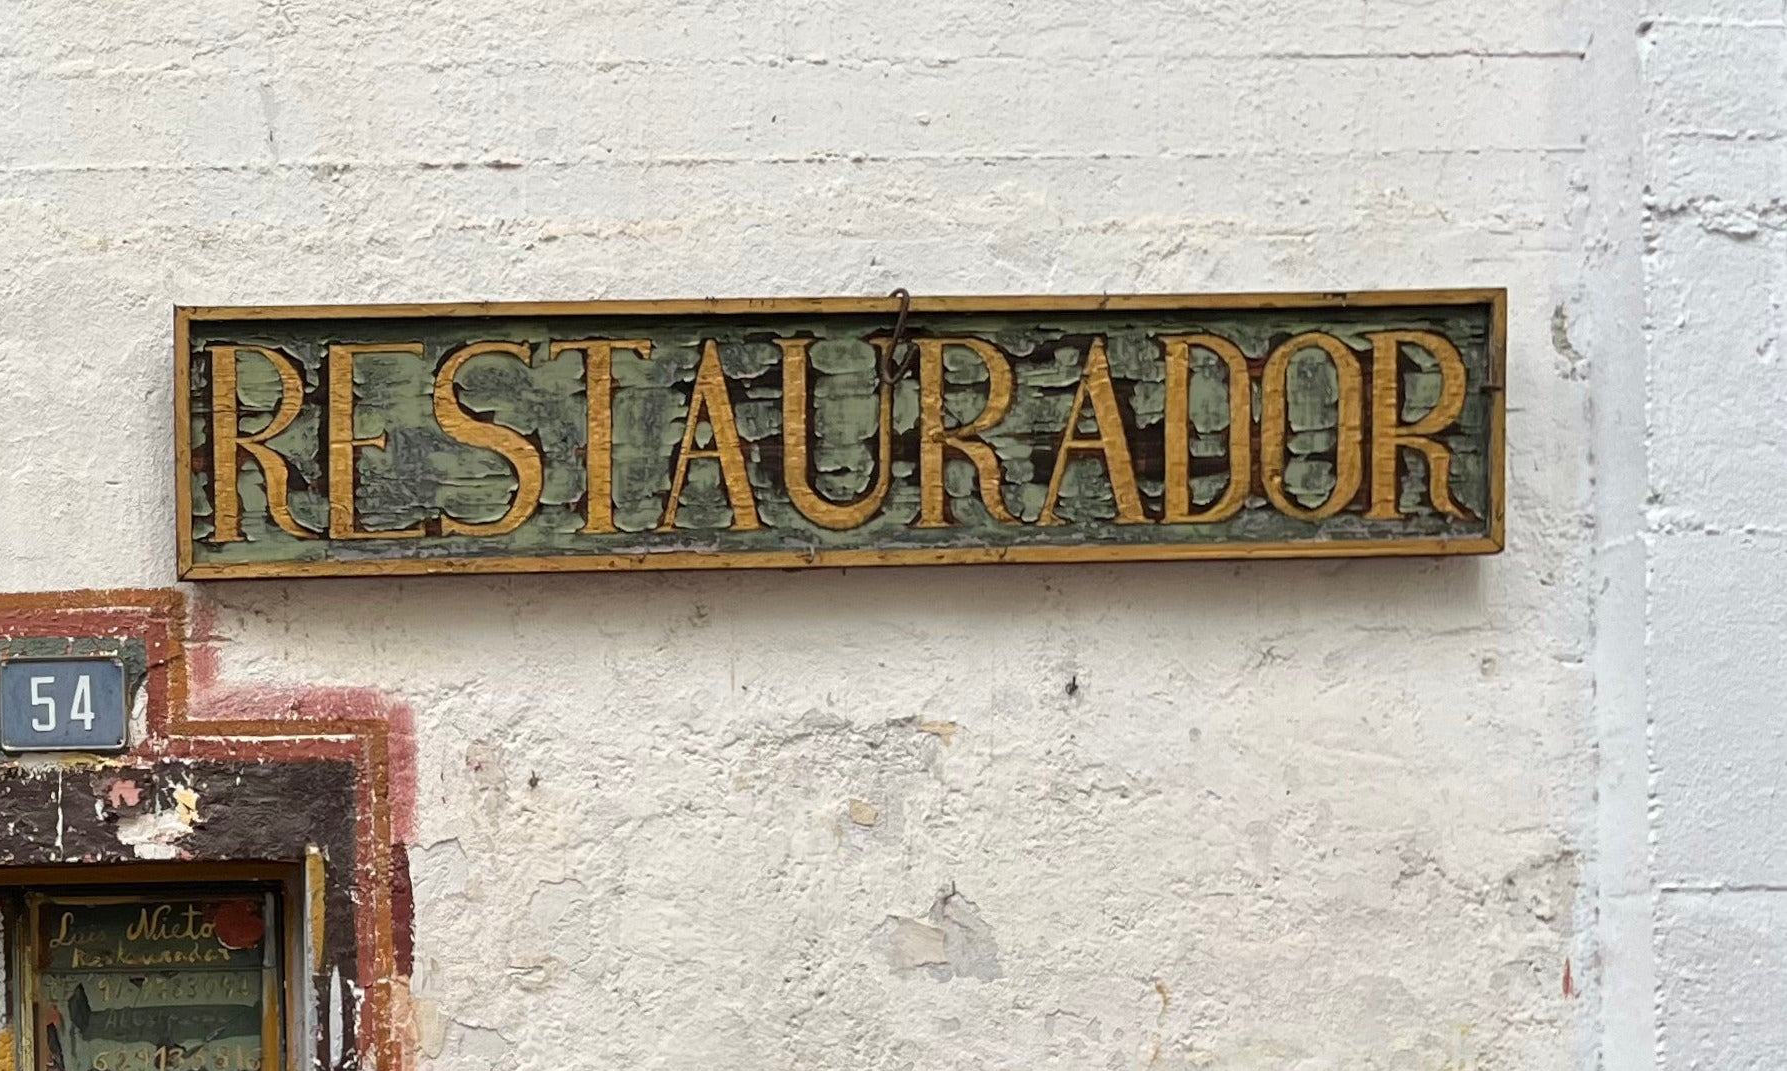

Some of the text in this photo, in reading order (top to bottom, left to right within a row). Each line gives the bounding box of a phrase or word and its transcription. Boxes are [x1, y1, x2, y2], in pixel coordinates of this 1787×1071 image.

[205, 328, 1471, 546] RESTAURADOR
[29, 674, 96, 732] 54
[125, 903, 216, 941] Nieto
